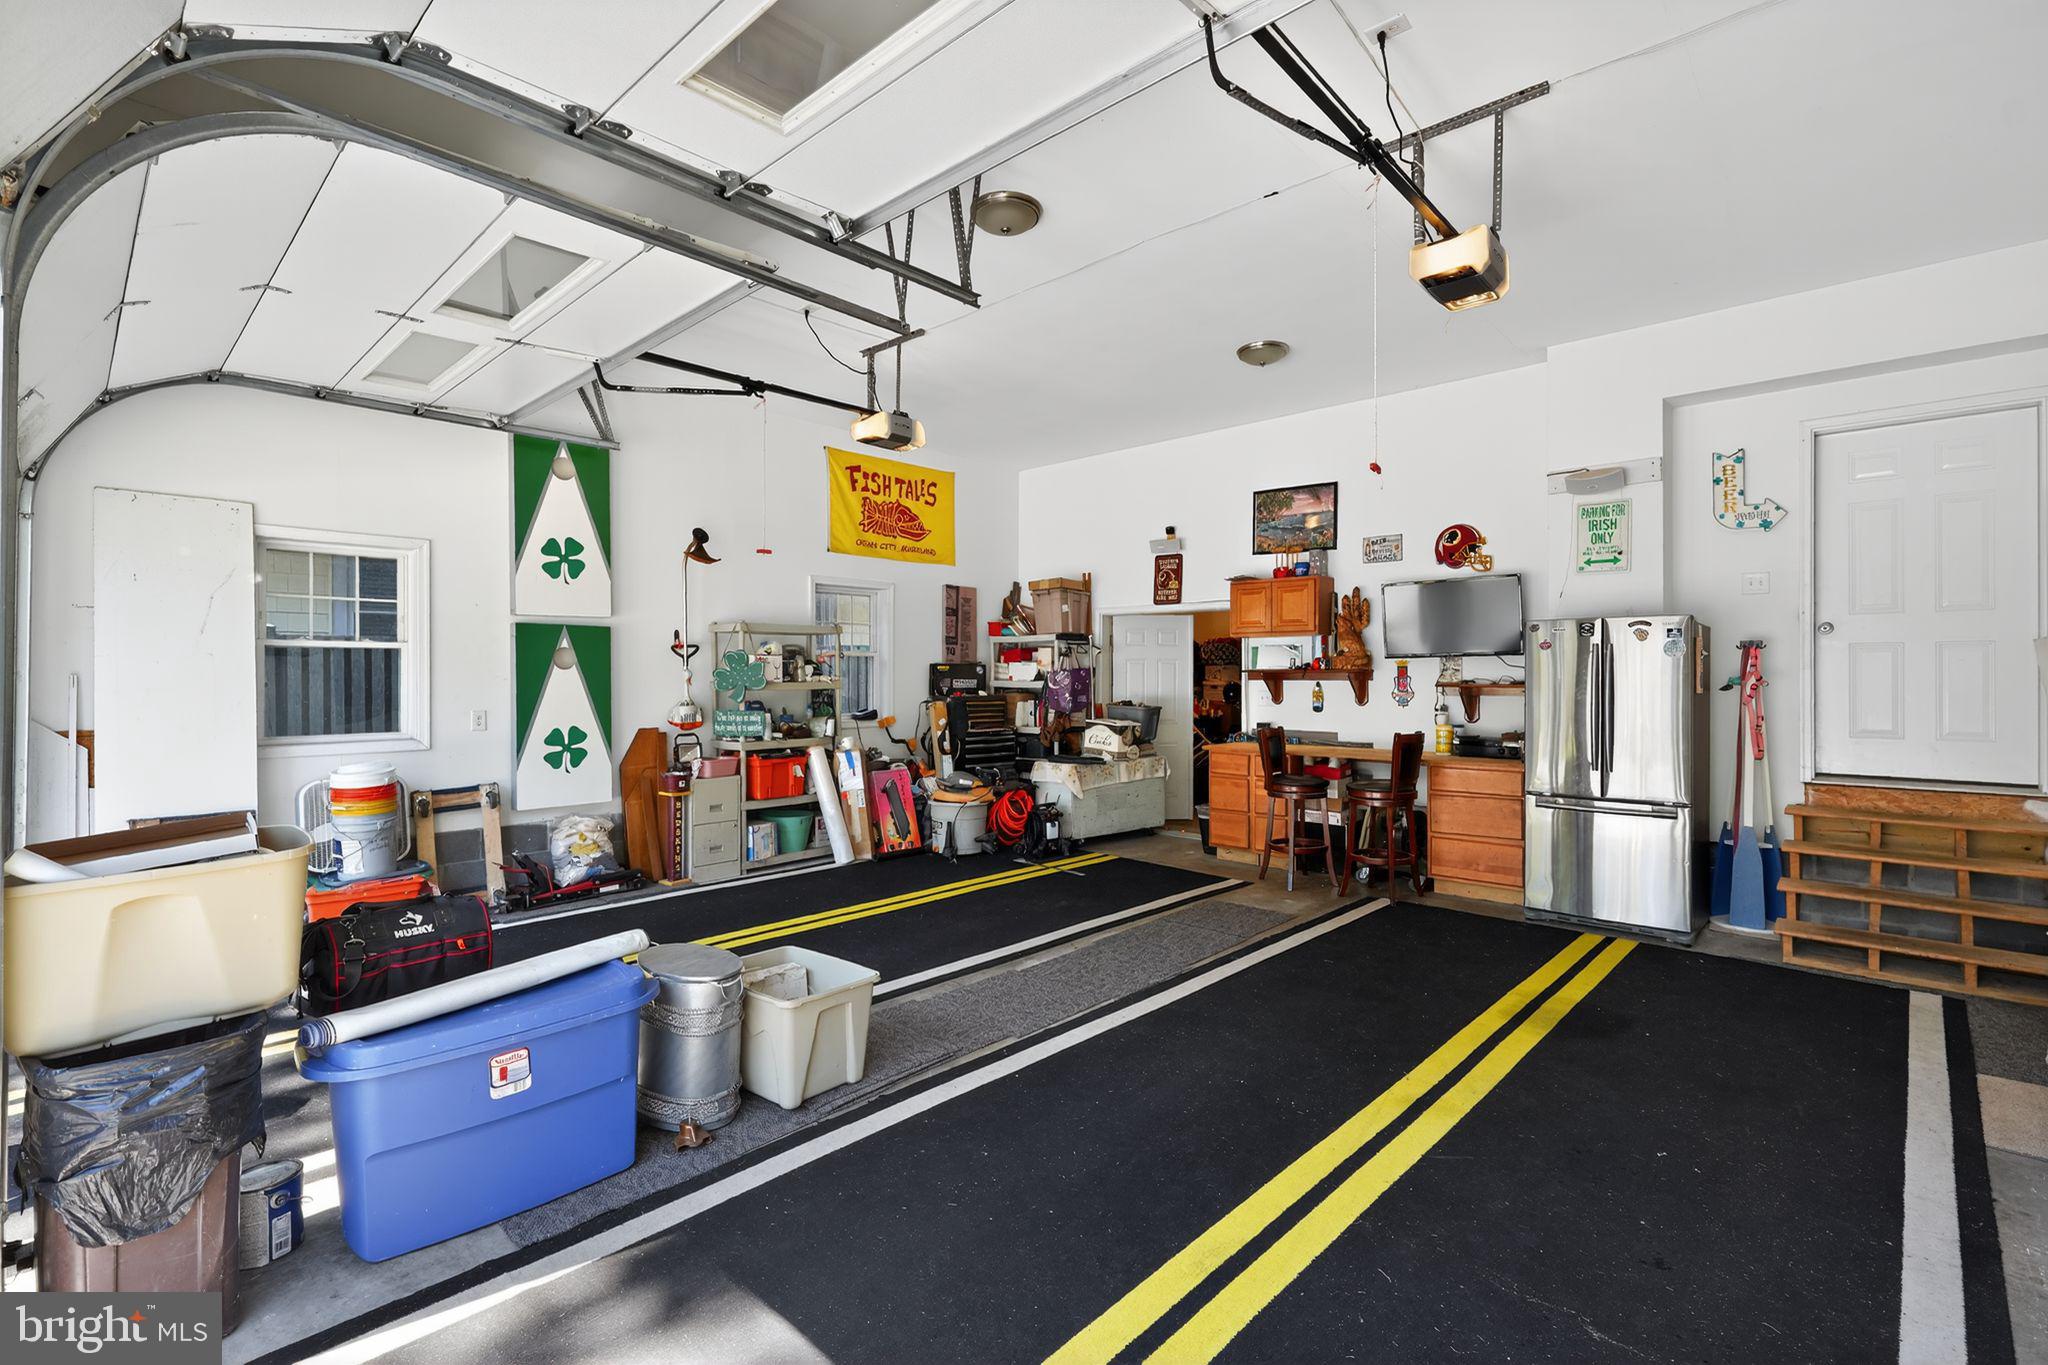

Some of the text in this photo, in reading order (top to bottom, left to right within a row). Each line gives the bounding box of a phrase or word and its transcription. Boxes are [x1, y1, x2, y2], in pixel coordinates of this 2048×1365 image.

[845, 465, 937, 507] FISH TALES
[1722, 464, 1737, 513] BEER
[1580, 503, 1626, 519] PARKING FOR
[1588, 518, 1617, 532] IRISH
[1590, 531, 1614, 545] ONLY
